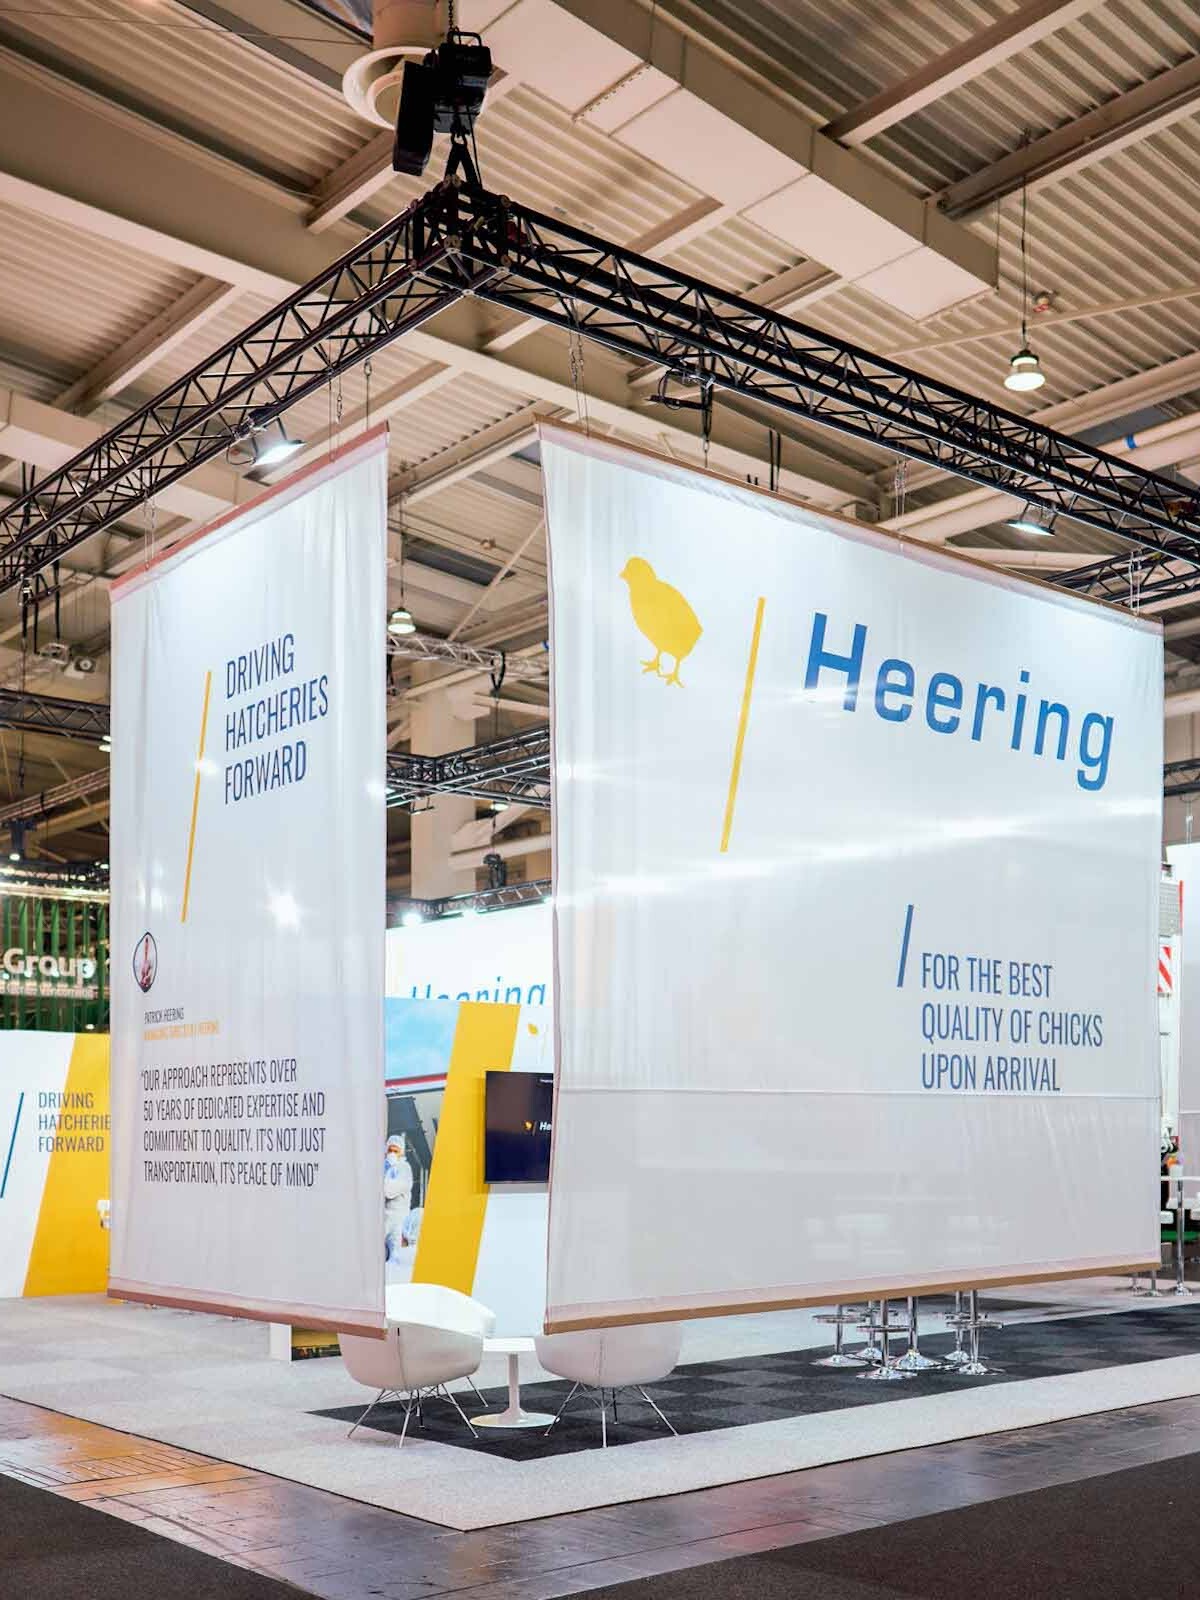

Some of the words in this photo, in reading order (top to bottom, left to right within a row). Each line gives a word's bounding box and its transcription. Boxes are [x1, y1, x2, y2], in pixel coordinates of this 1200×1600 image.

[226, 633, 295, 699] DRIVING
[226, 674, 328, 752] HATCHERIES
[803, 612, 1115, 791] Heering
[225, 740, 307, 805] FORWARD
[922, 952, 960, 991] FOR
[967, 957, 1002, 995] THE
[1009, 961, 1052, 998] BEST
[922, 1002, 1003, 1045] QUALITY
[1010, 1009, 1033, 1044] OF
[1039, 1011, 1103, 1047] CHICKS
[161, 1066, 208, 1090] APPROACH
[211, 1060, 267, 1087] REPRESENTS
[270, 1058, 297, 1083] OVER
[922, 1053, 976, 1090] UPON
[984, 1056, 1060, 1092] ARRIVAL
[39, 1092, 94, 1108] DRIVING
[144, 1100, 153, 1121] 50
[156, 1098, 182, 1121] YEARS
[184, 1098, 196, 1120] OF
[198, 1095, 244, 1120] DEDICATED
[247, 1093, 299, 1118] EXPERTISE
[301, 1092, 325, 1117] AND
[39, 1136, 104, 1152] FORWARD
[144, 1130, 198, 1151] COMMITMENT
[201, 1129, 212, 1151] TO
[214, 1128, 253, 1154] QUALITY.
[256, 1128, 273, 1152] IT'S
[276, 1128, 297, 1152] NOT
[300, 1128, 326, 1152] JUST
[144, 1161, 218, 1185] TRANSPORTATION,
[220, 1162, 236, 1184] IT'S
[238, 1162, 267, 1185] PEACE
[270, 1162, 283, 1186] OF
